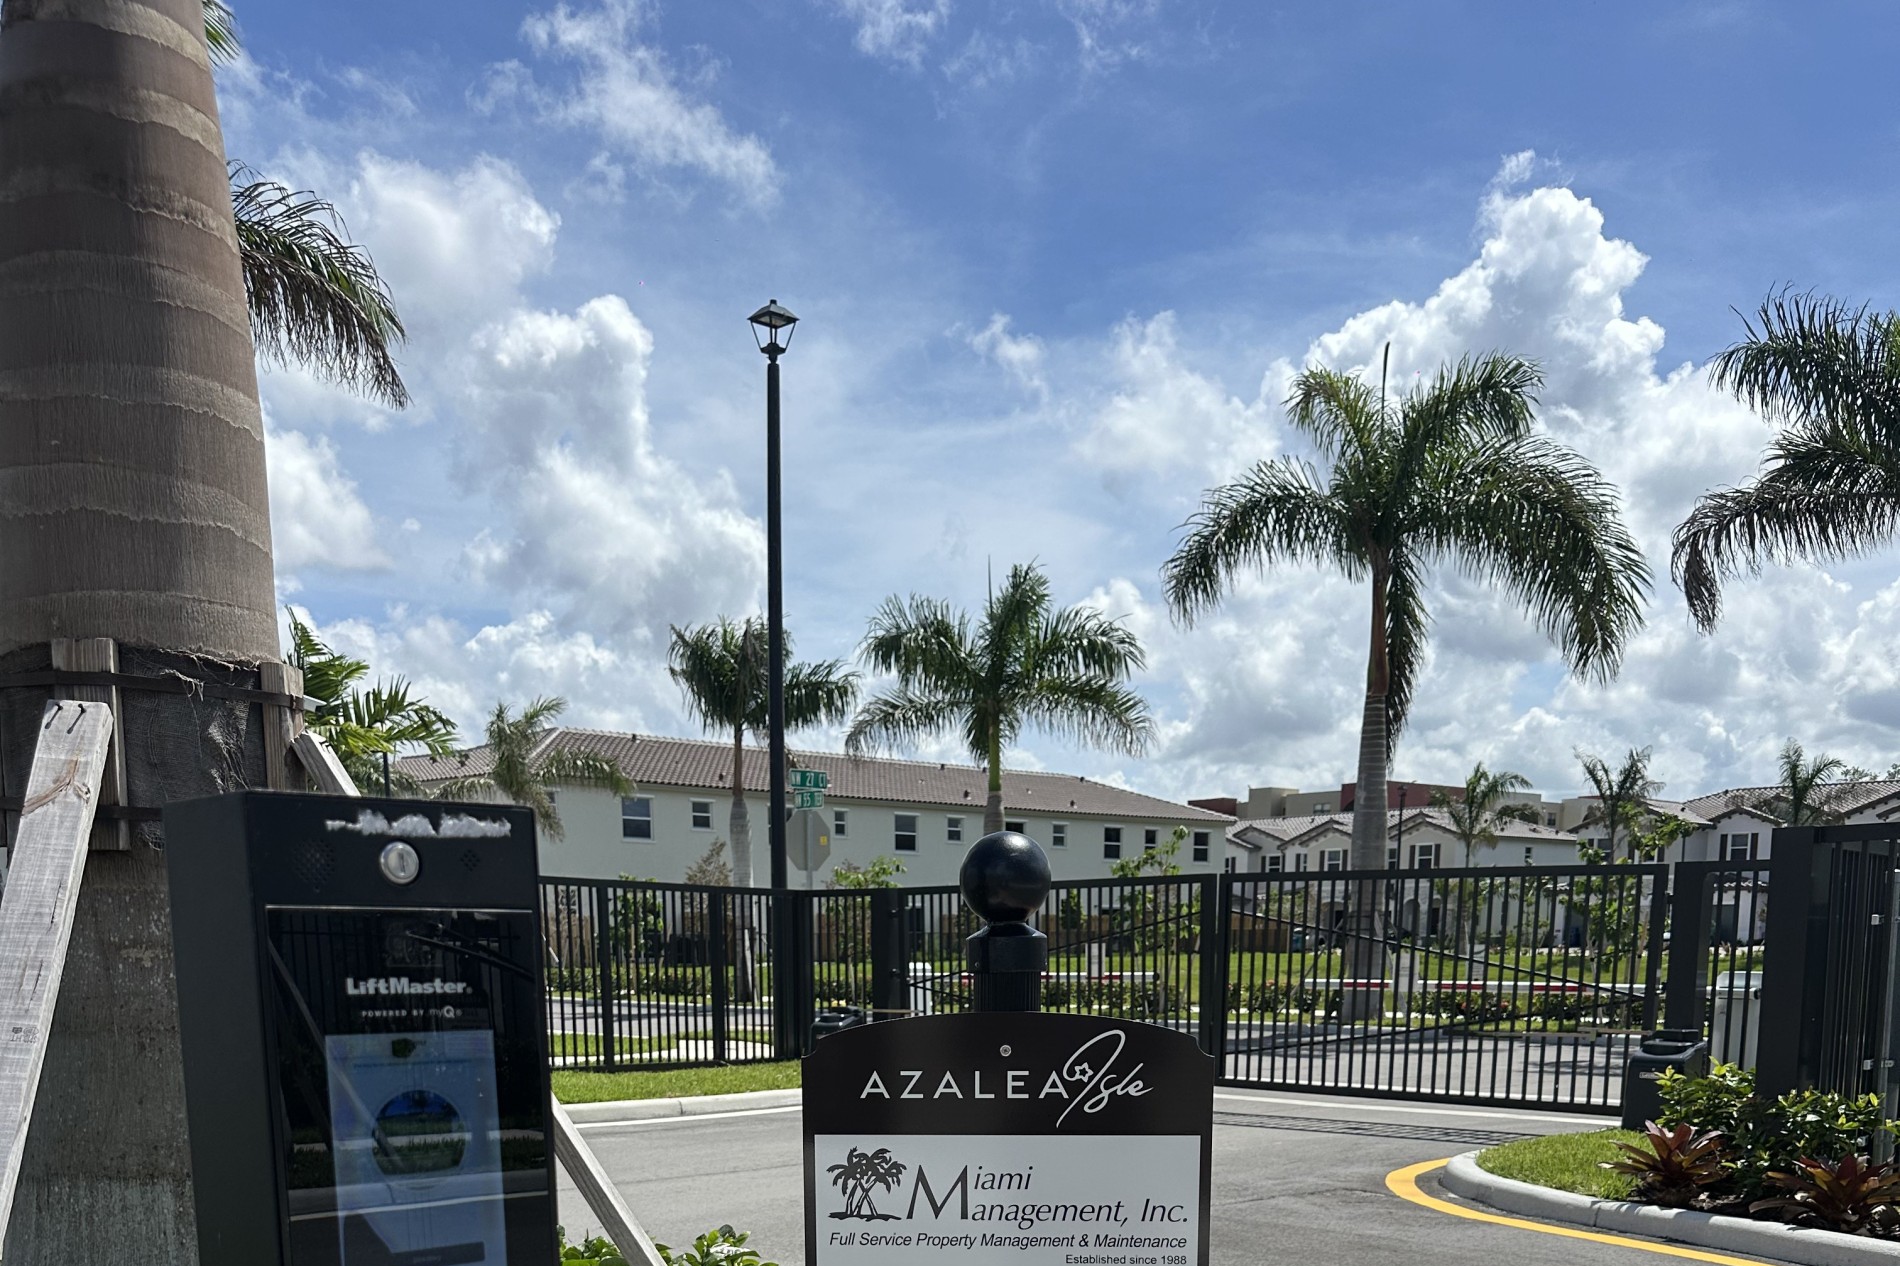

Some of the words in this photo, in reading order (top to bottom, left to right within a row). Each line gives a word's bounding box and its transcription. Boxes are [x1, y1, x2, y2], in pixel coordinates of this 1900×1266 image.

[806, 772, 815, 787] 27
[819, 773, 826, 788] CT
[803, 792, 811, 807] 55
[361, 1009, 408, 1018] POWERED
[412, 1009, 424, 1017] BY
[860, 1071, 1070, 1099] AZALEA
[1056, 1029, 1154, 1128] Isle
[1140, 1198, 1188, 1223] Inc.
[829, 1232, 856, 1246] Full
[859, 1232, 912, 1246] Service
[916, 1233, 977, 1250] Property
[980, 1233, 1075, 1250] Management
[1078, 1234, 1089, 1248] &
[1093, 1234, 1187, 1248] Maintenance
[1065, 1254, 1126, 1265] Established
[1129, 1254, 1157, 1265] since
[1161, 1255, 1187, 1265] 1988
